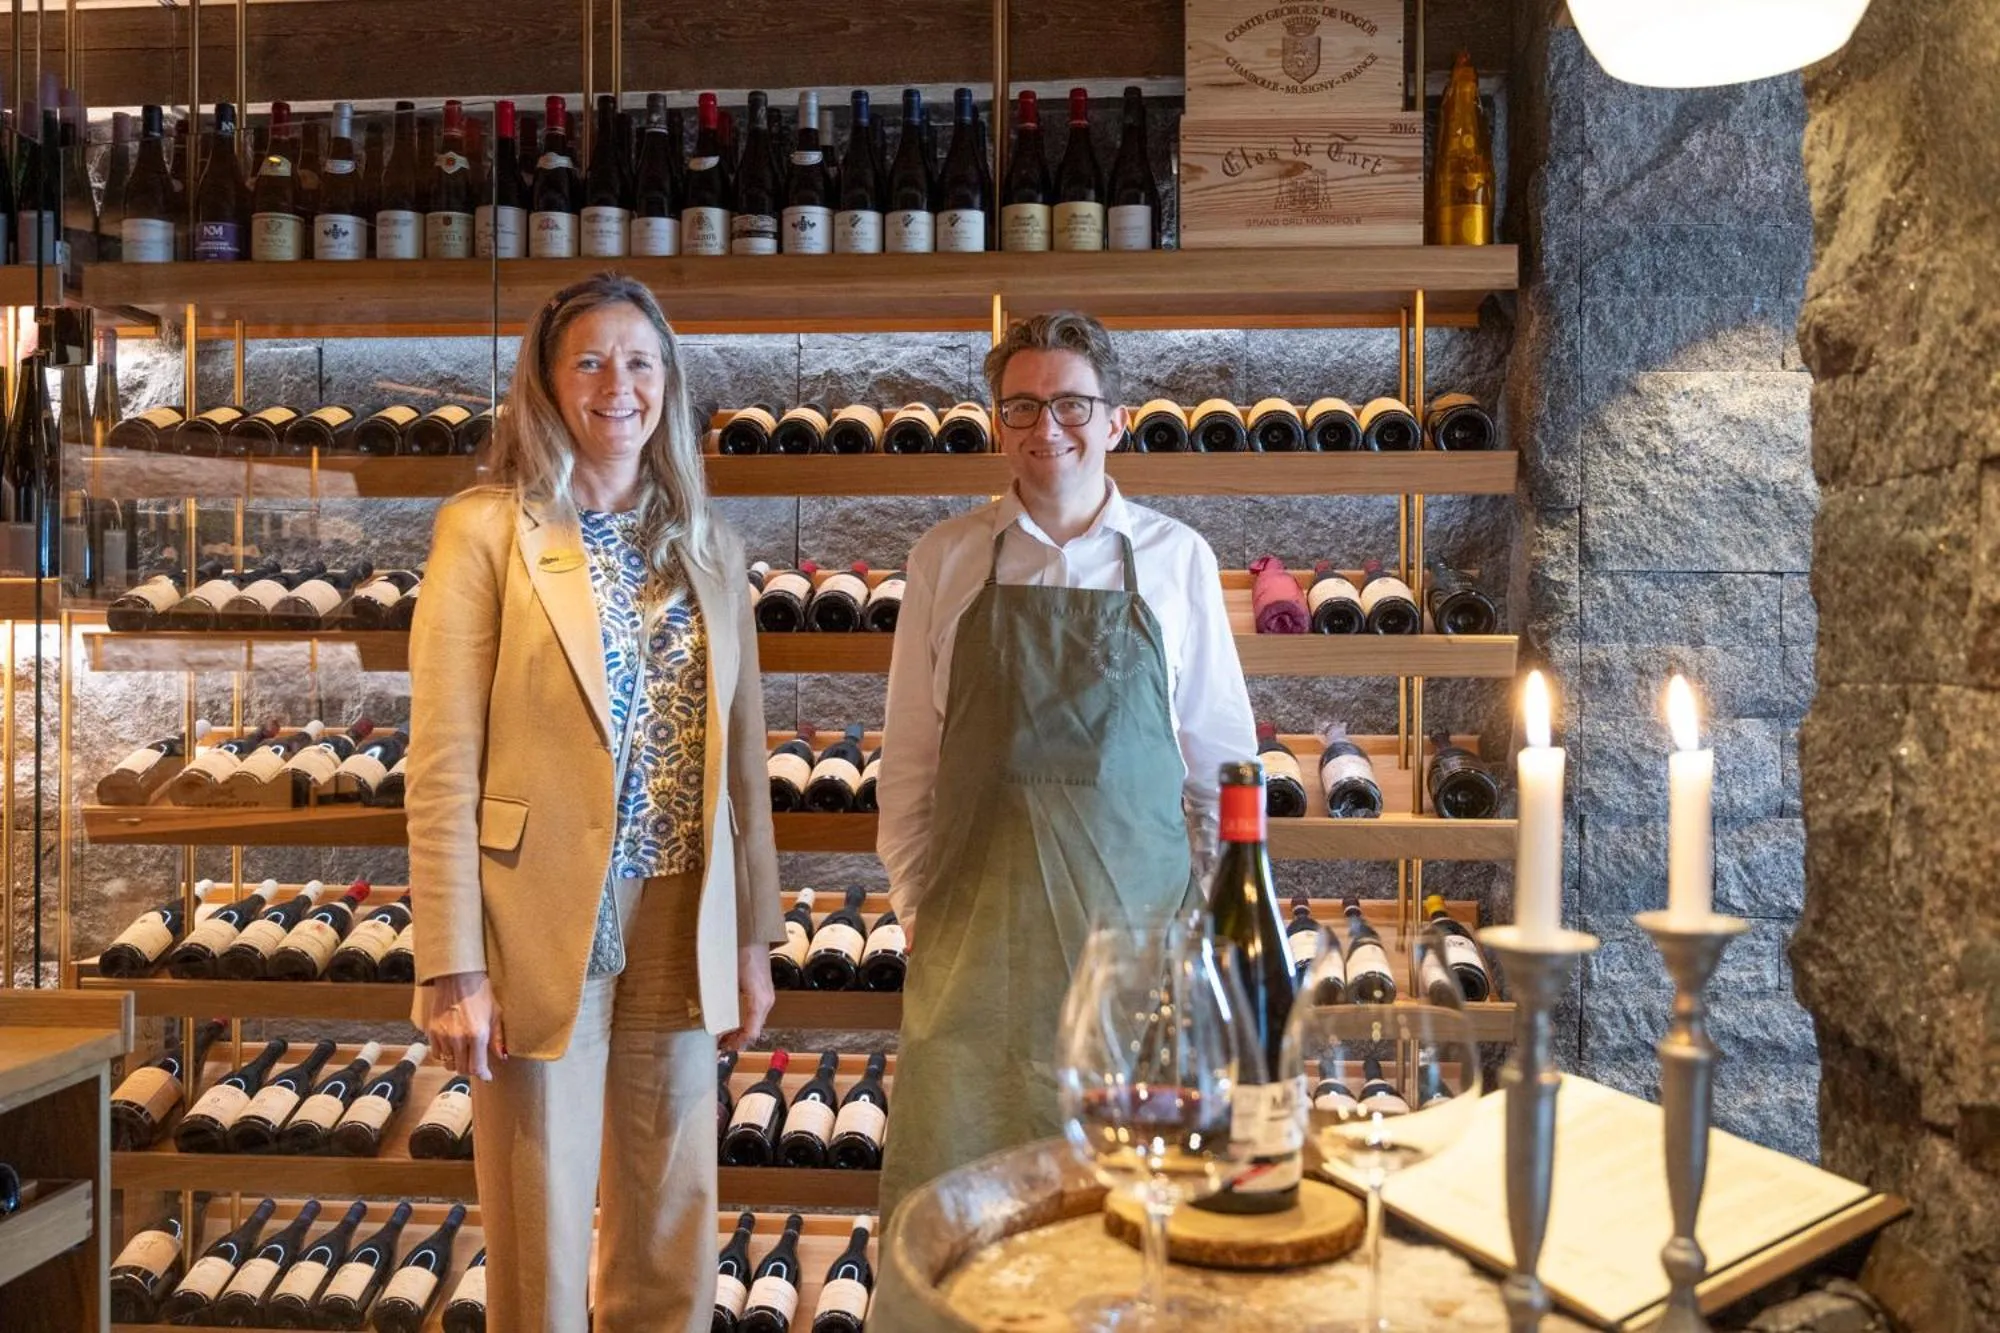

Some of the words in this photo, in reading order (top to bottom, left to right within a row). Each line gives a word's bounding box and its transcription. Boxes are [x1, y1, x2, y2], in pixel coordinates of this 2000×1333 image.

[1224, 14, 1265, 43] COMTE
[1265, 5, 1319, 21] GEORGES
[1321, 6, 1338, 18] DE
[1221, 146, 1279, 178] Clos
[1292, 137, 1312, 156] de
[1327, 133, 1384, 175] Tart
[1245, 217, 1279, 227] GRAND
